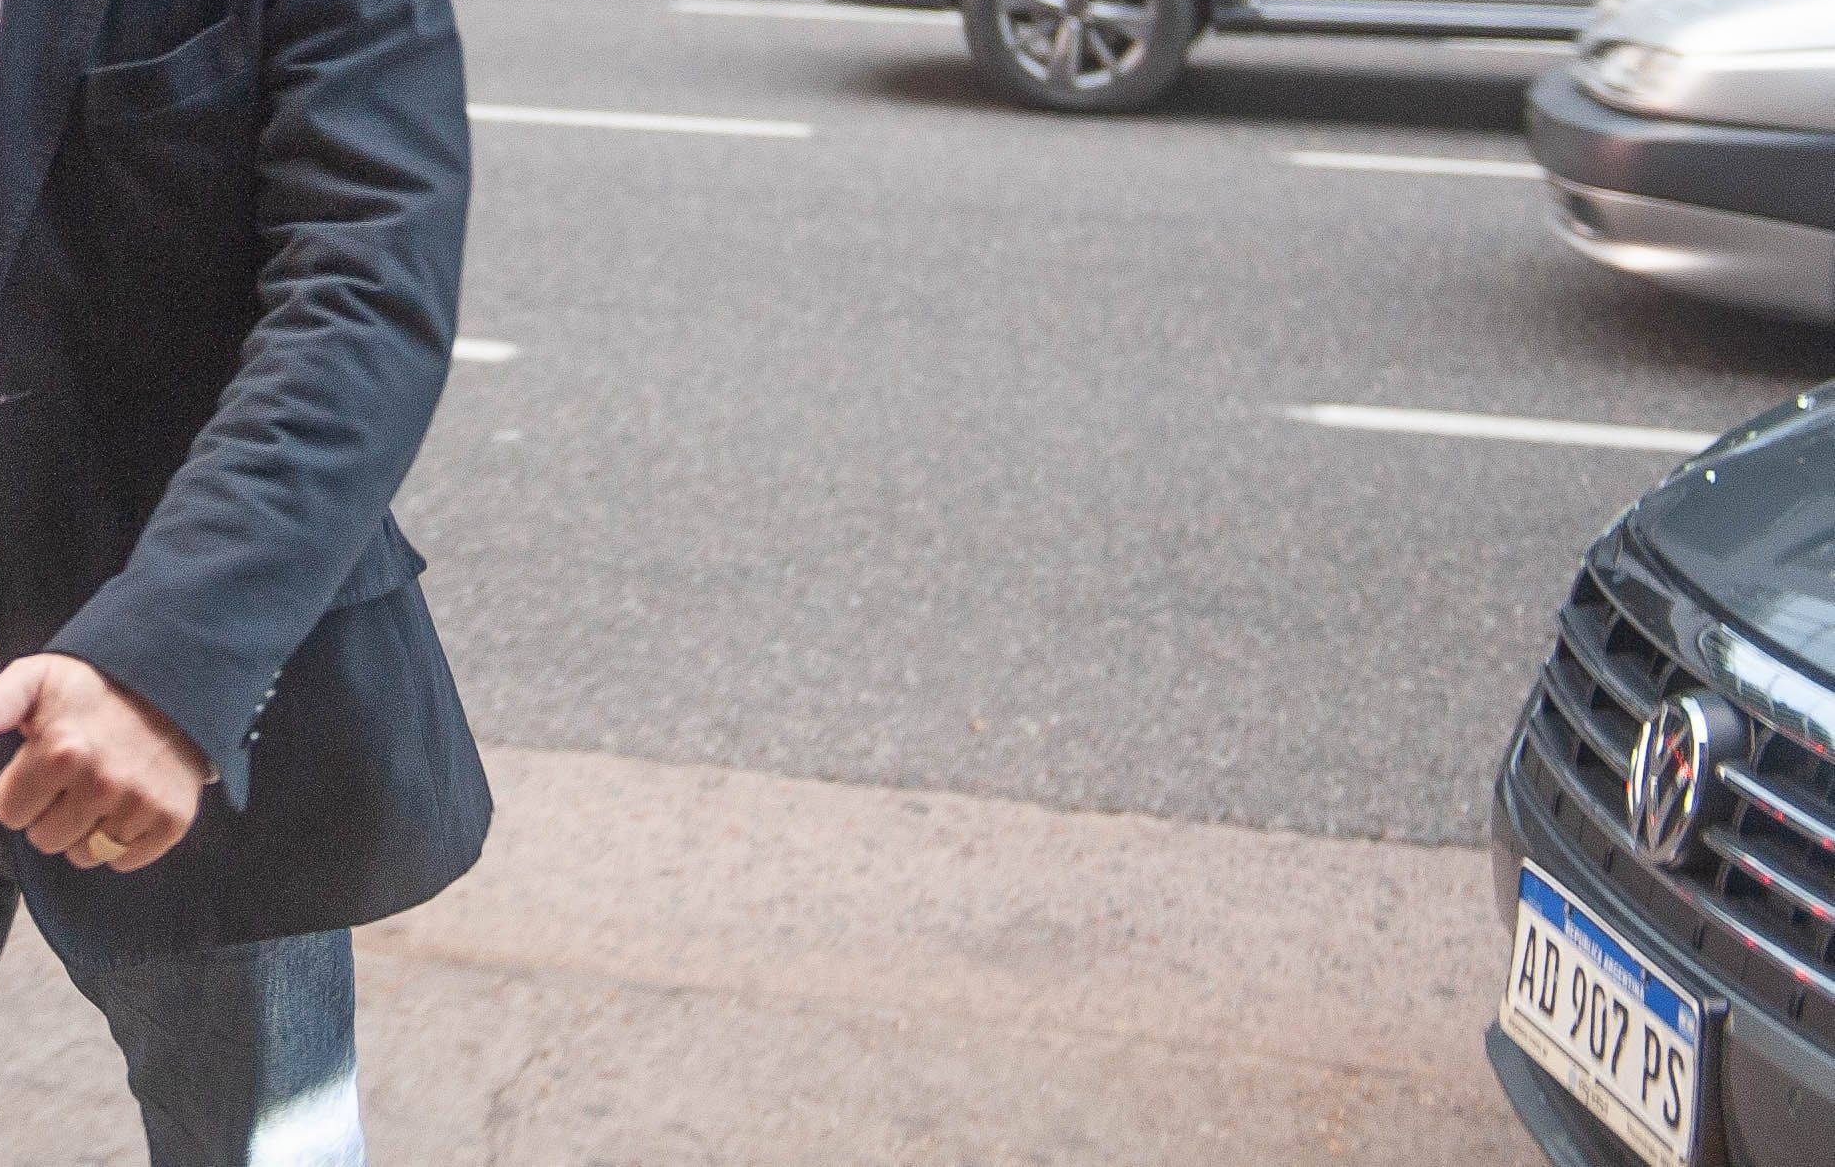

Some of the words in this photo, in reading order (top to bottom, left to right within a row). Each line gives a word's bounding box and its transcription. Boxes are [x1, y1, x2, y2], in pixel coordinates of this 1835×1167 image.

[1518, 923, 1561, 1016] AD
[1570, 965, 1629, 1074] 907
[1641, 1023, 1686, 1130] PS
